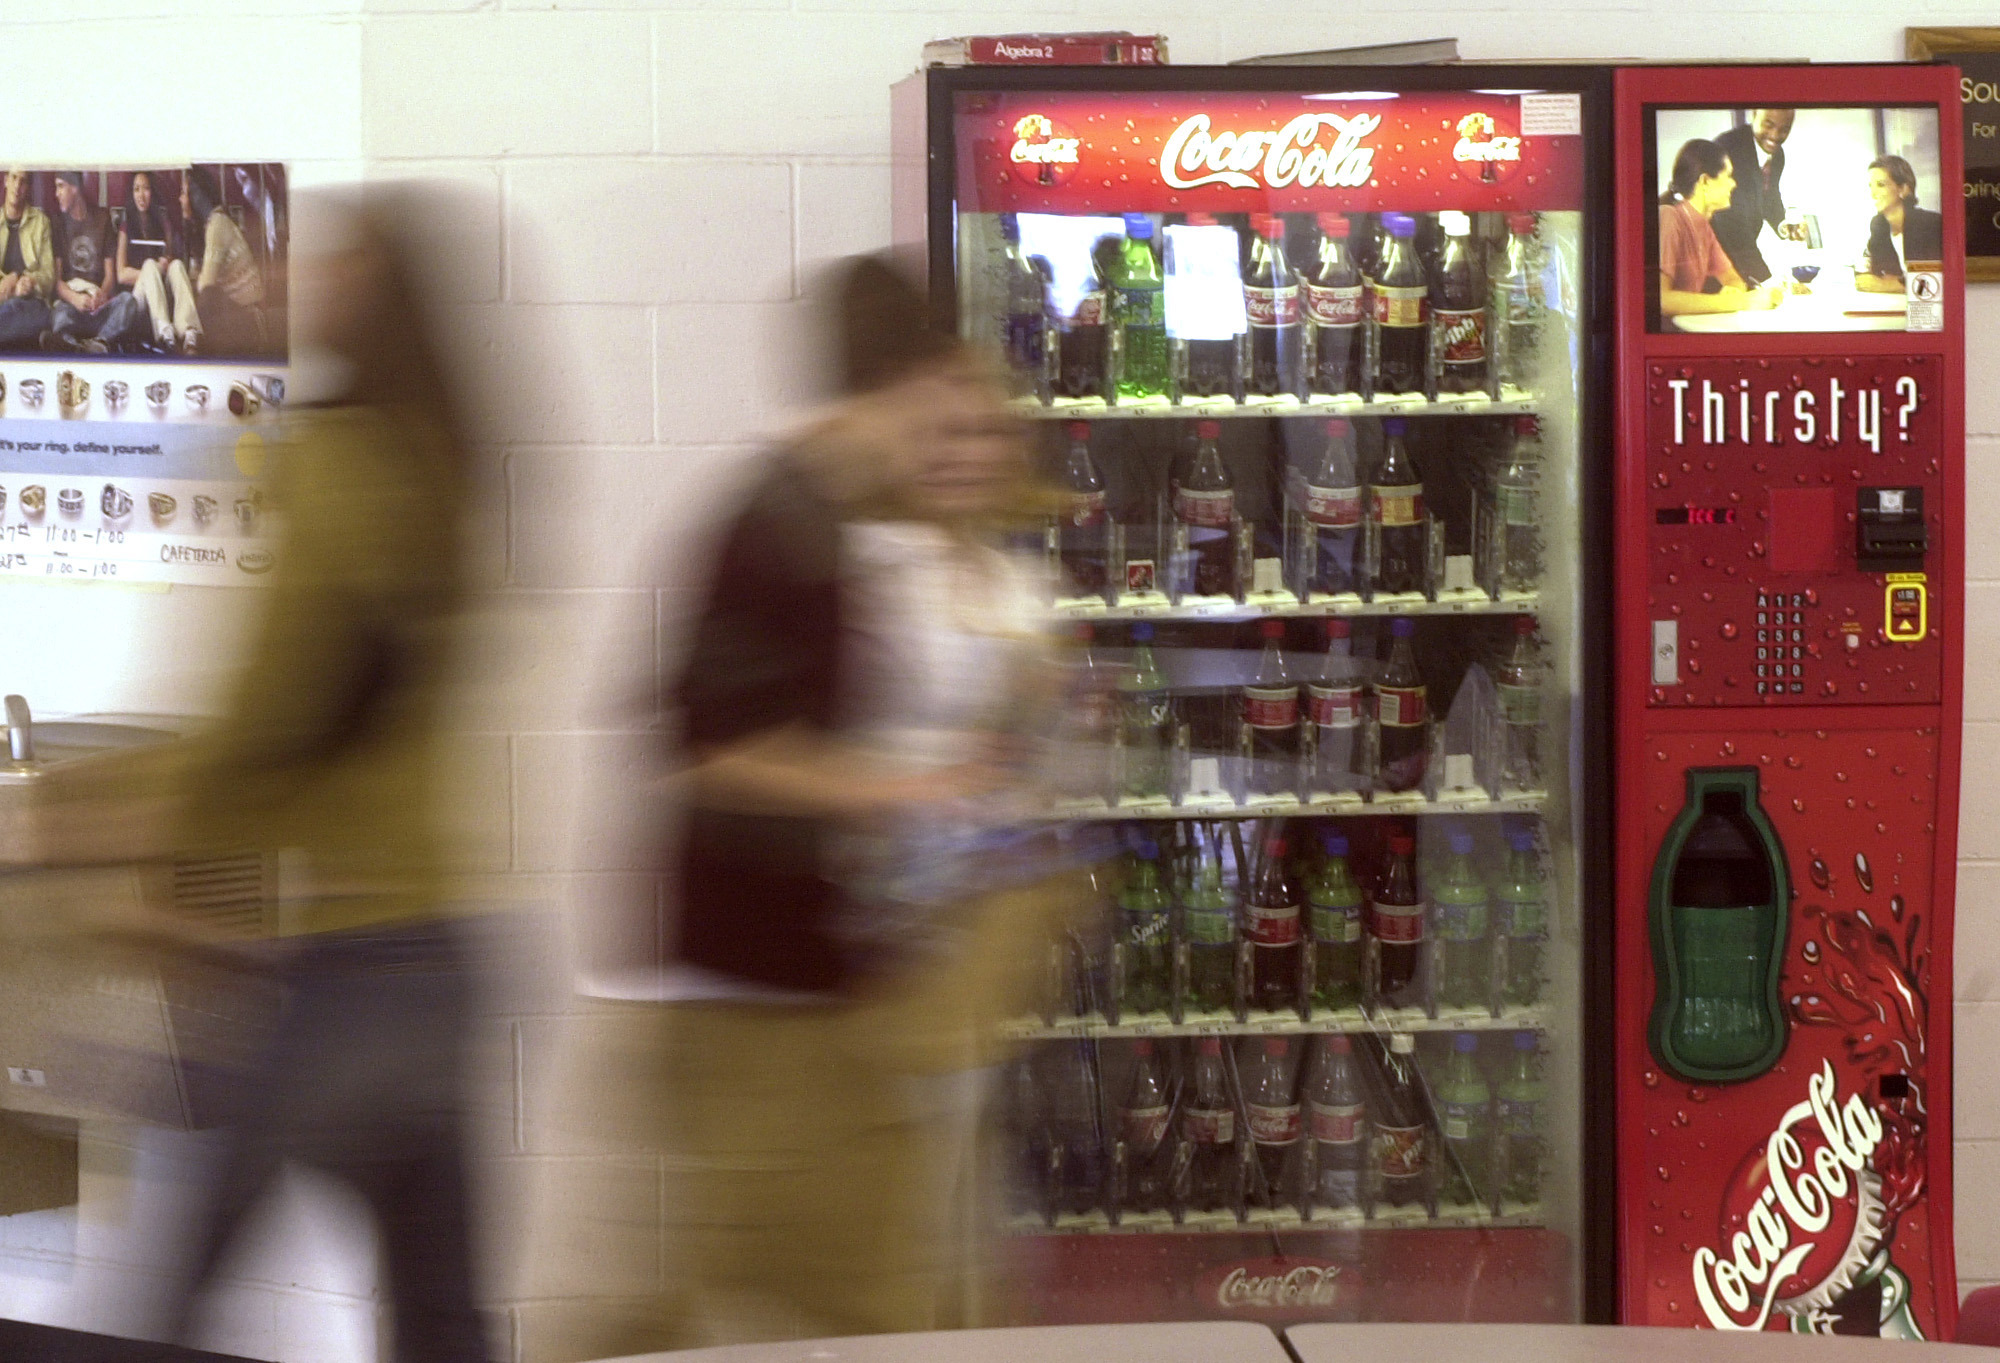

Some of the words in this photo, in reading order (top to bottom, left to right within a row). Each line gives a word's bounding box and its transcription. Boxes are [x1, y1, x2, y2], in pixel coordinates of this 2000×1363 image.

[994, 42, 1043, 60] Algebra
[1044, 46, 1053, 58] 2
[1668, 376, 1918, 454] Thirsty?
[17, 441, 42, 453] your
[73, 442, 110, 453] define
[160, 544, 226, 563] CAFETERIA
[1693, 1057, 1883, 1331] Coca-Cola
